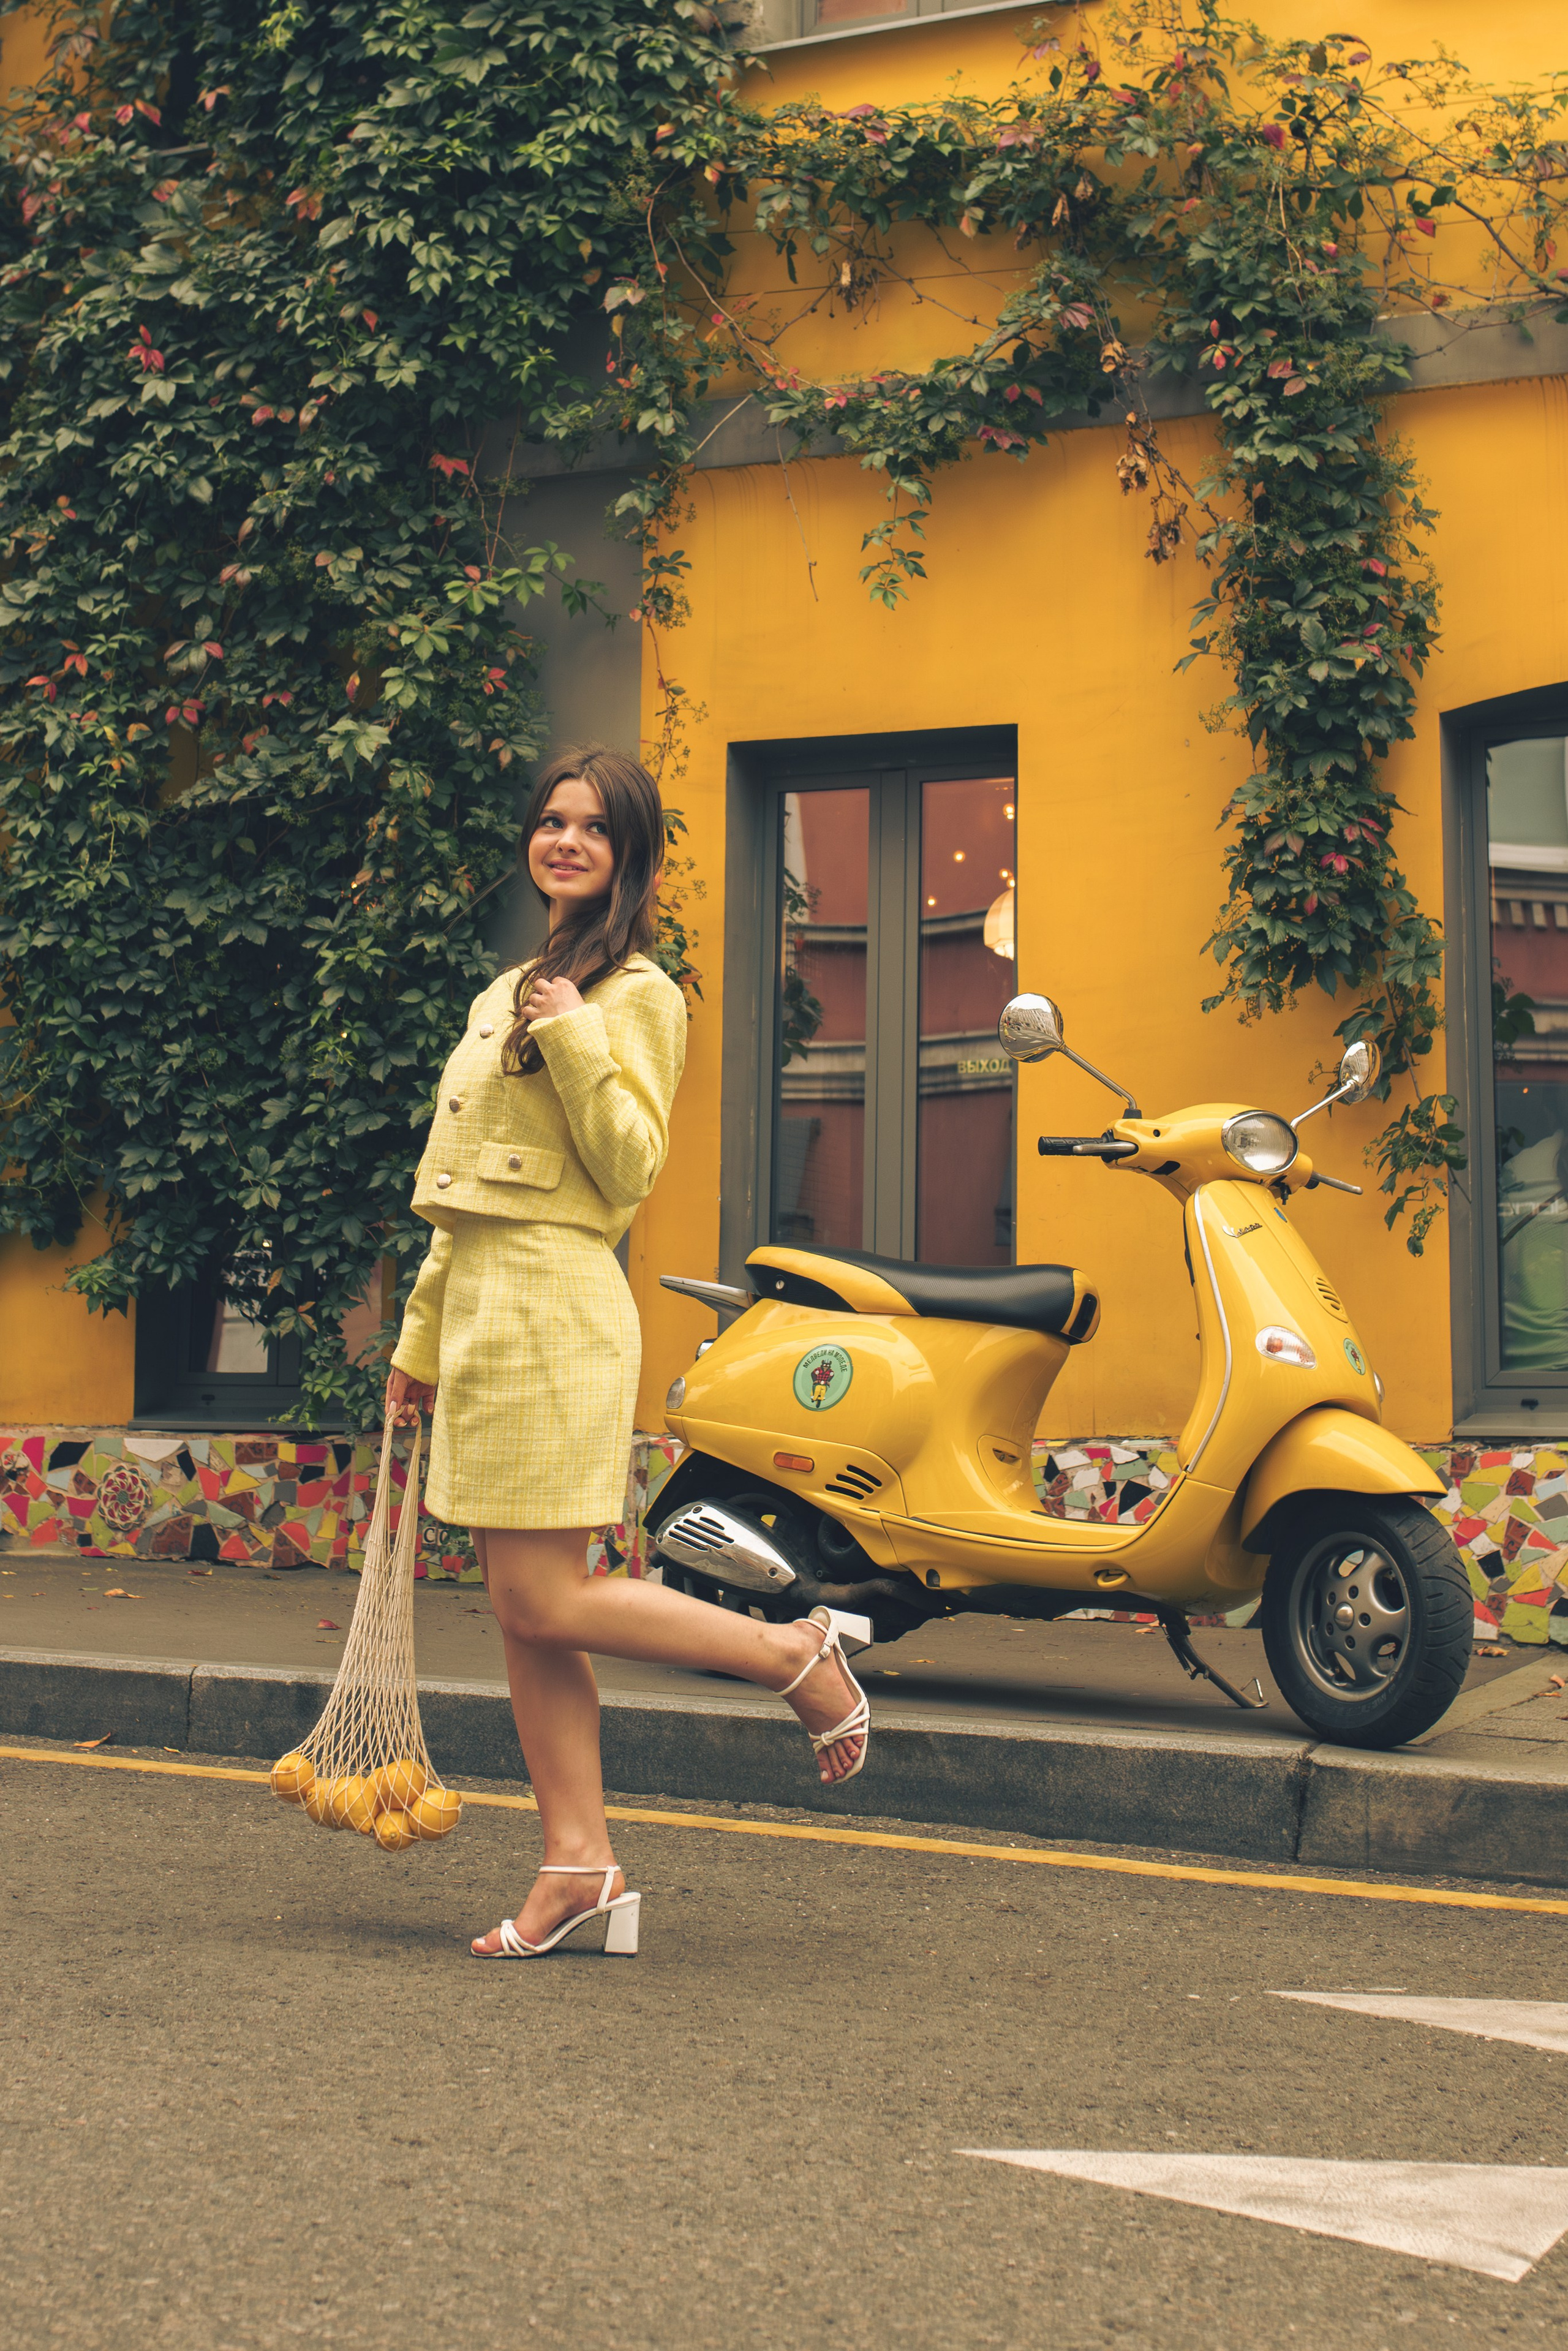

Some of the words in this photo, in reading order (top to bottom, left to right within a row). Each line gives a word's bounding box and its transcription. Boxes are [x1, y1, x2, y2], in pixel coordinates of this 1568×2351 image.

[957, 1058, 1012, 1074] ВЫХОД
[1222, 1223, 1263, 1238] Vespa
[803, 1349, 827, 1368] МЕДВЕДИ
[834, 1351, 848, 1372] МОПЕДЕ
